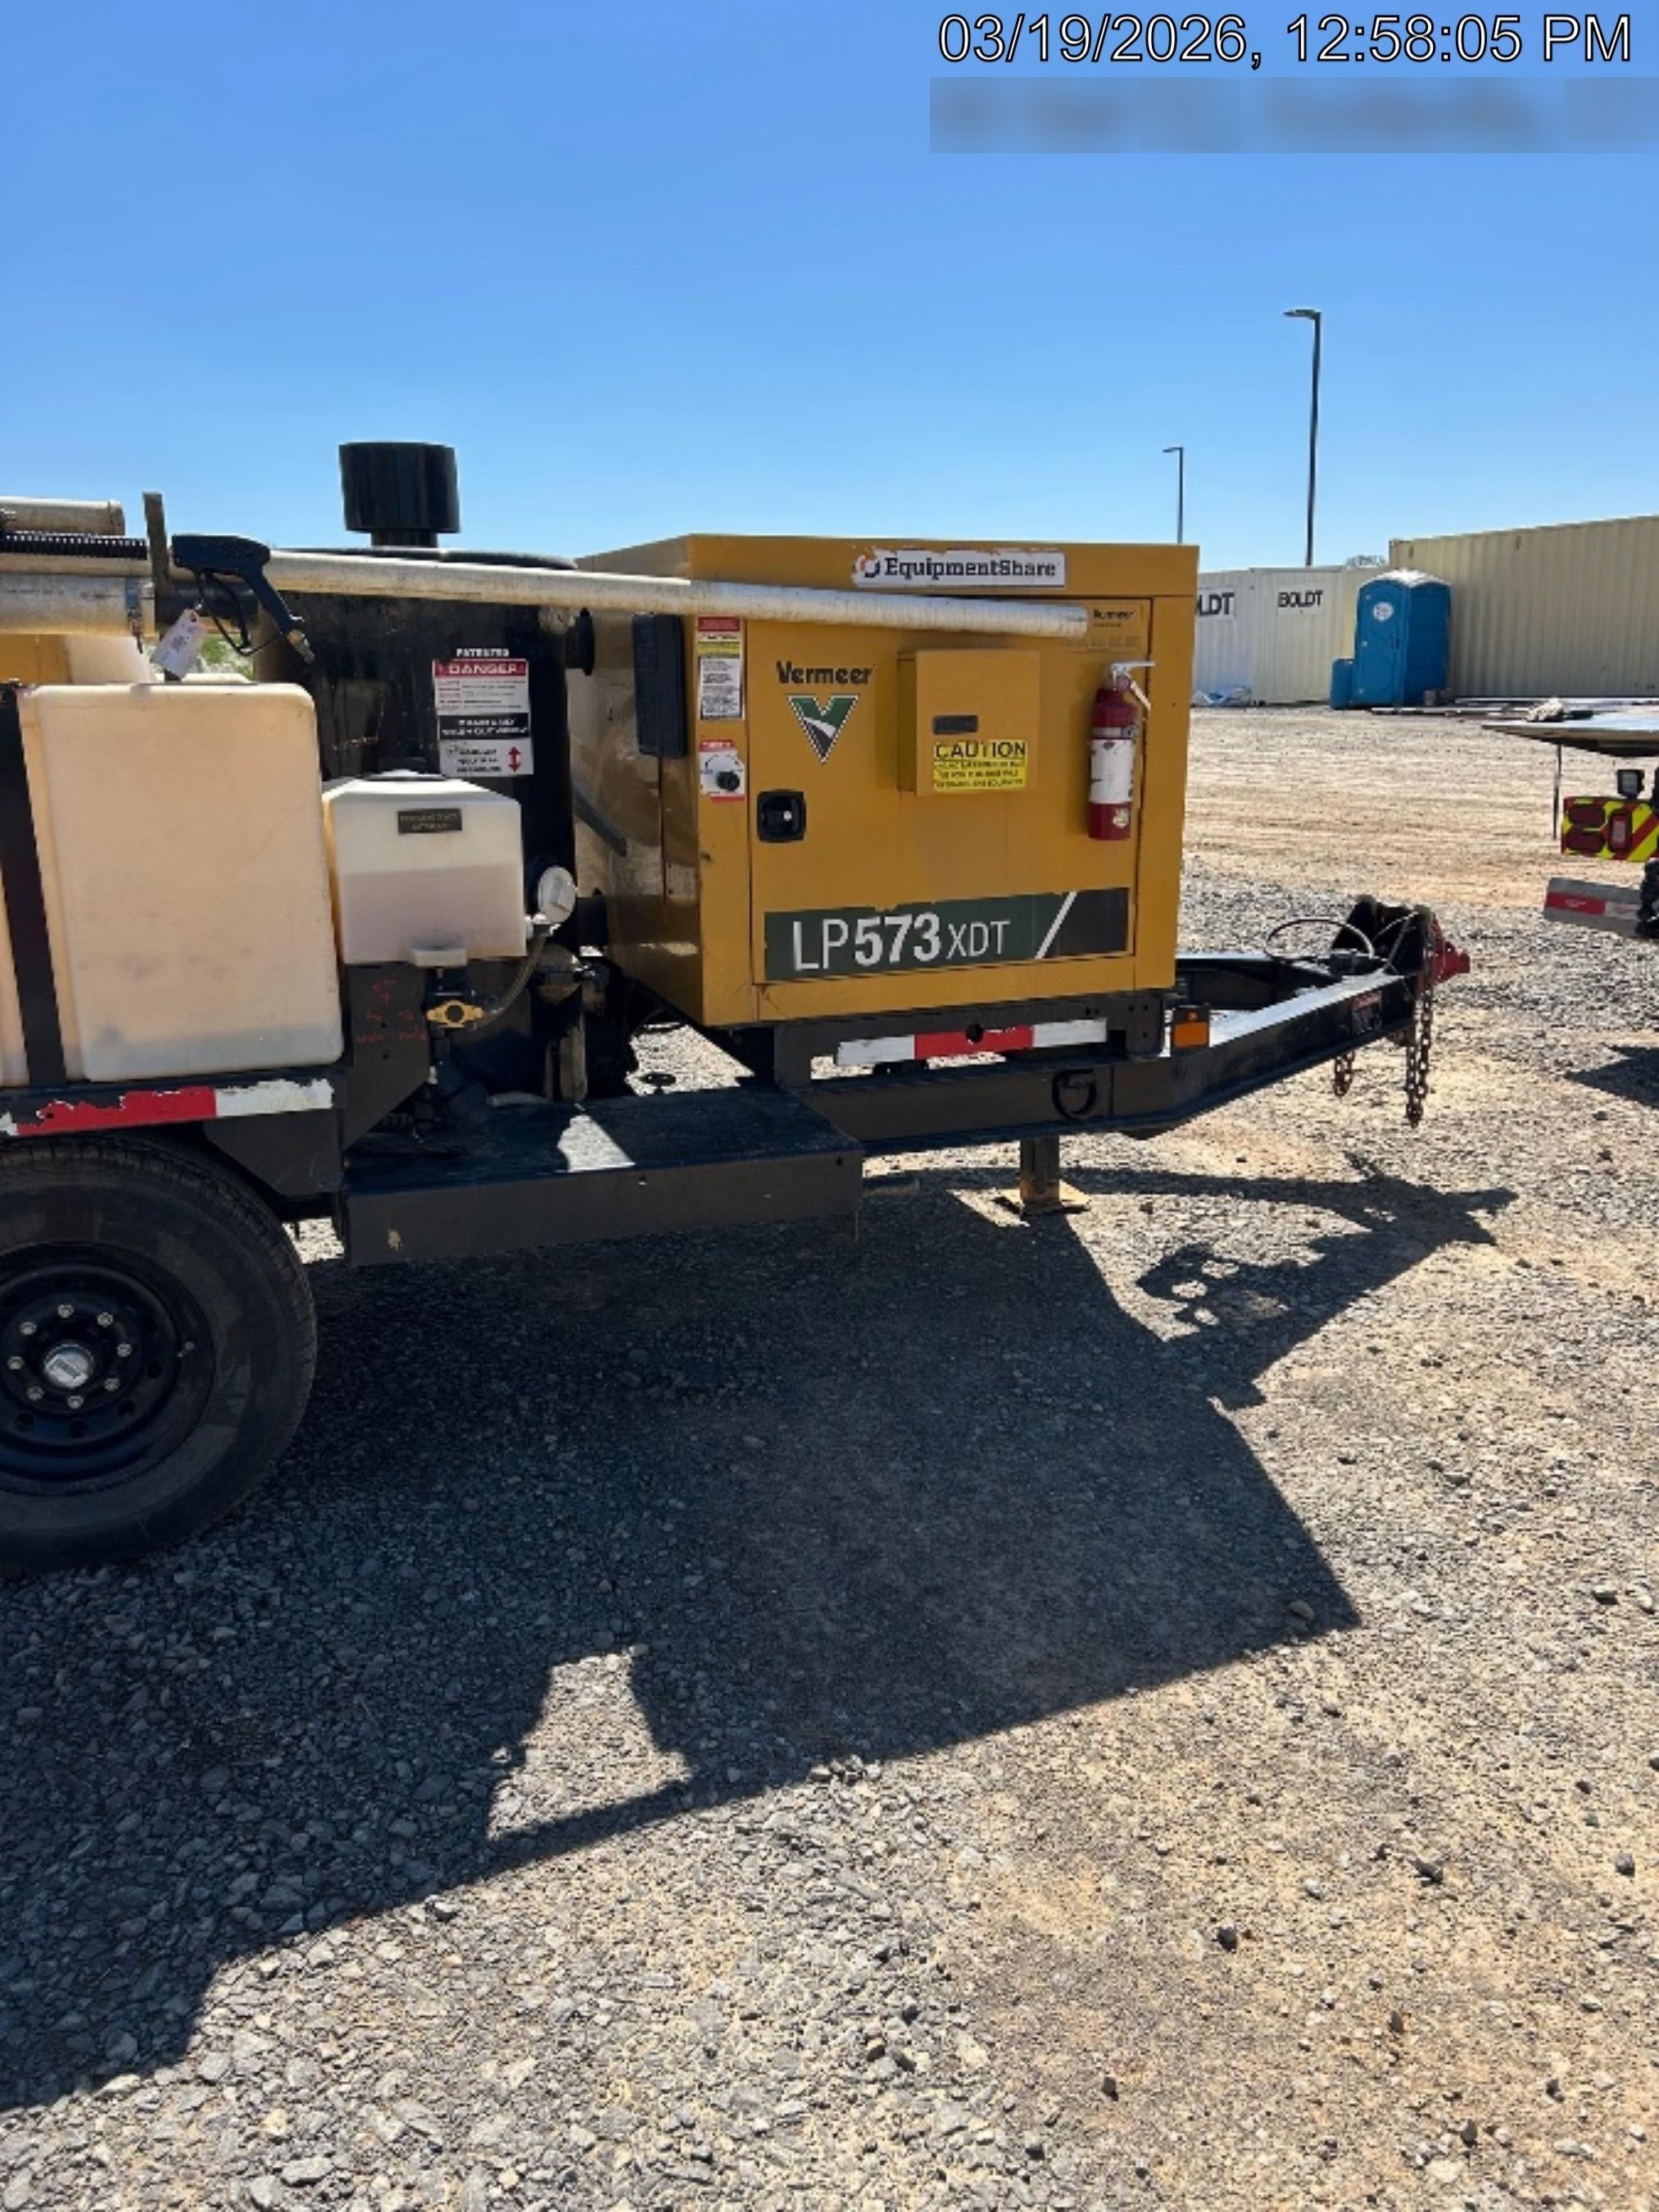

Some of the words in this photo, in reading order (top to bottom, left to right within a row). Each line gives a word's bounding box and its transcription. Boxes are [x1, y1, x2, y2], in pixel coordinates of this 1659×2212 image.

[884, 557, 1056, 580] EquipmentShare
[1197, 592, 1235, 616] LDT
[1277, 590, 1323, 608] BOLDT
[776, 660, 873, 684] Vermeer
[935, 741, 1026, 758] CAUTION
